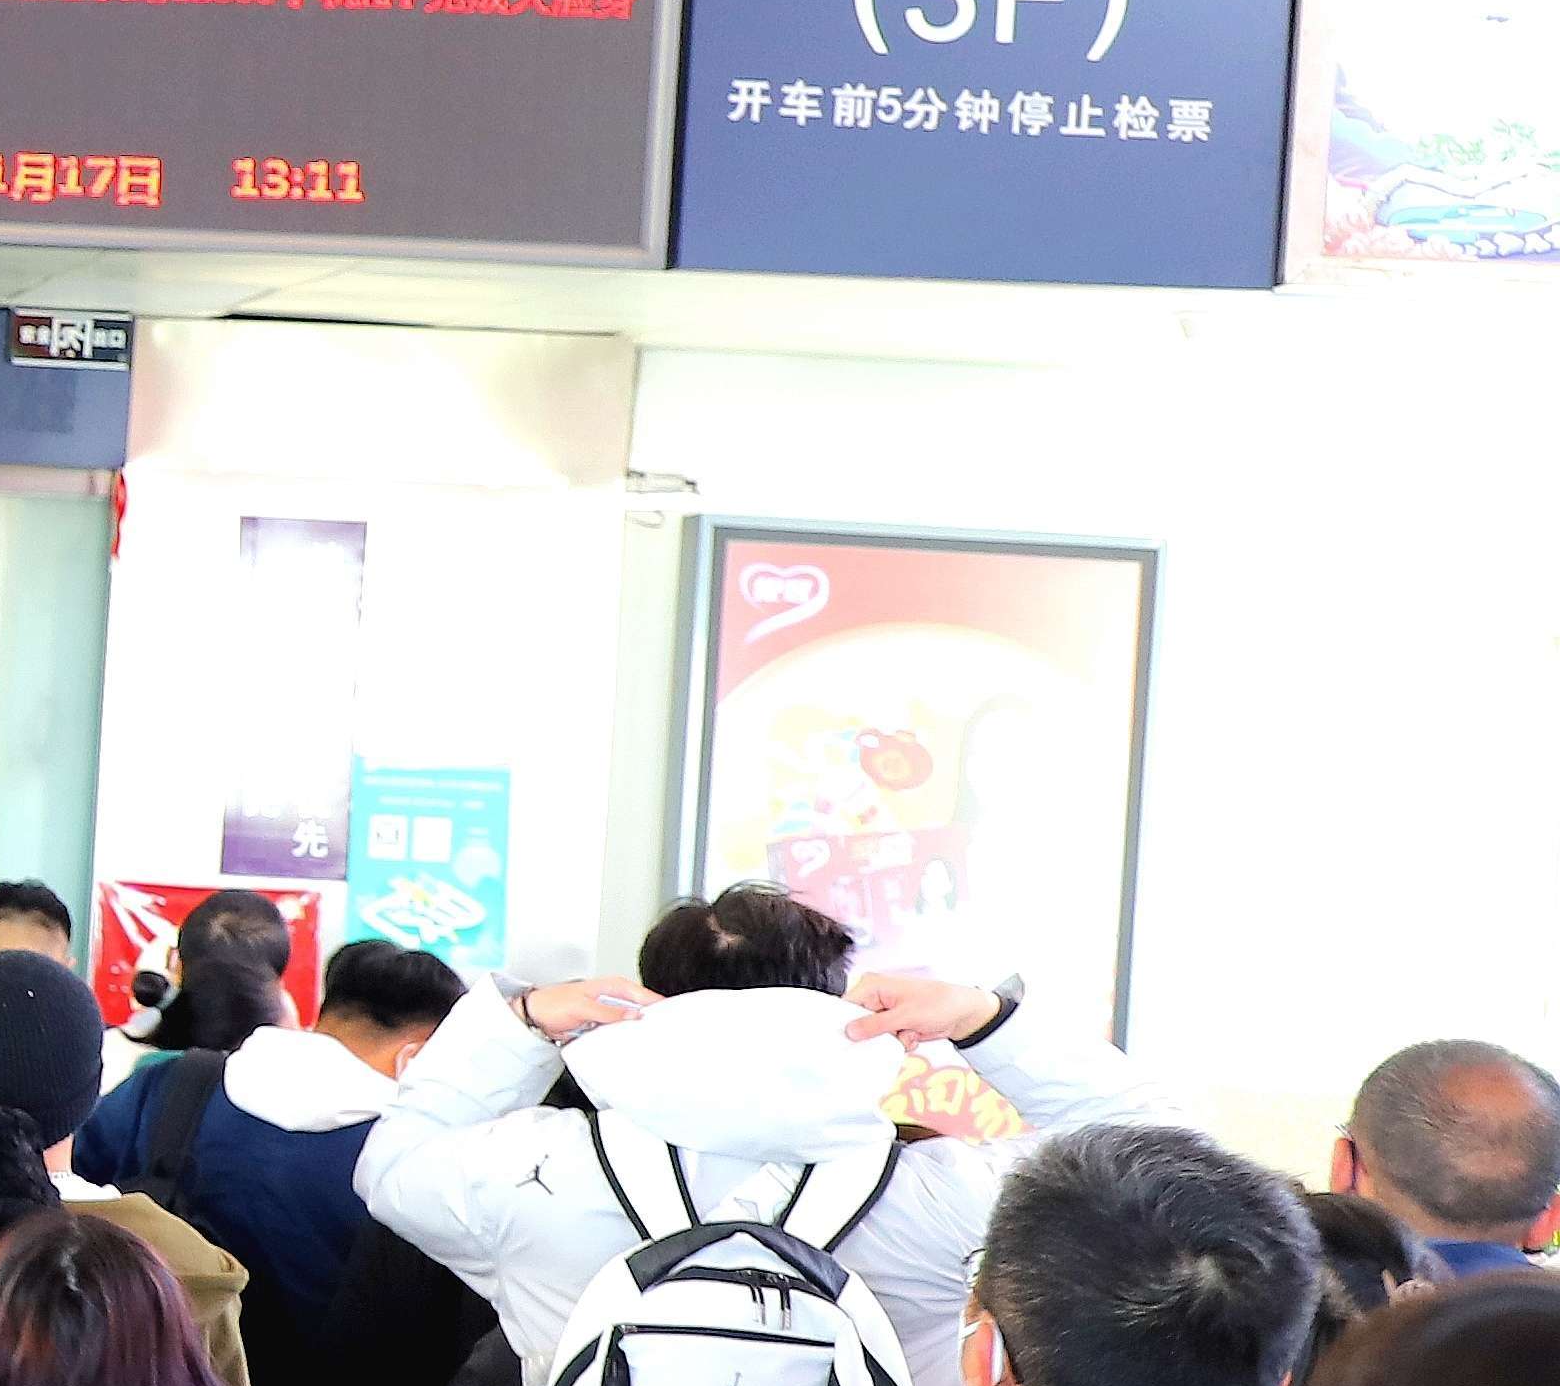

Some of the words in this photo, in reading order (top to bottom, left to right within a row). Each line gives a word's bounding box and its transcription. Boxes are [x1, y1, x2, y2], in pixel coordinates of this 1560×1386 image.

[726, 77, 1214, 145] 开车前5分钟停止检票
[230, 157, 365, 205] 13:11
